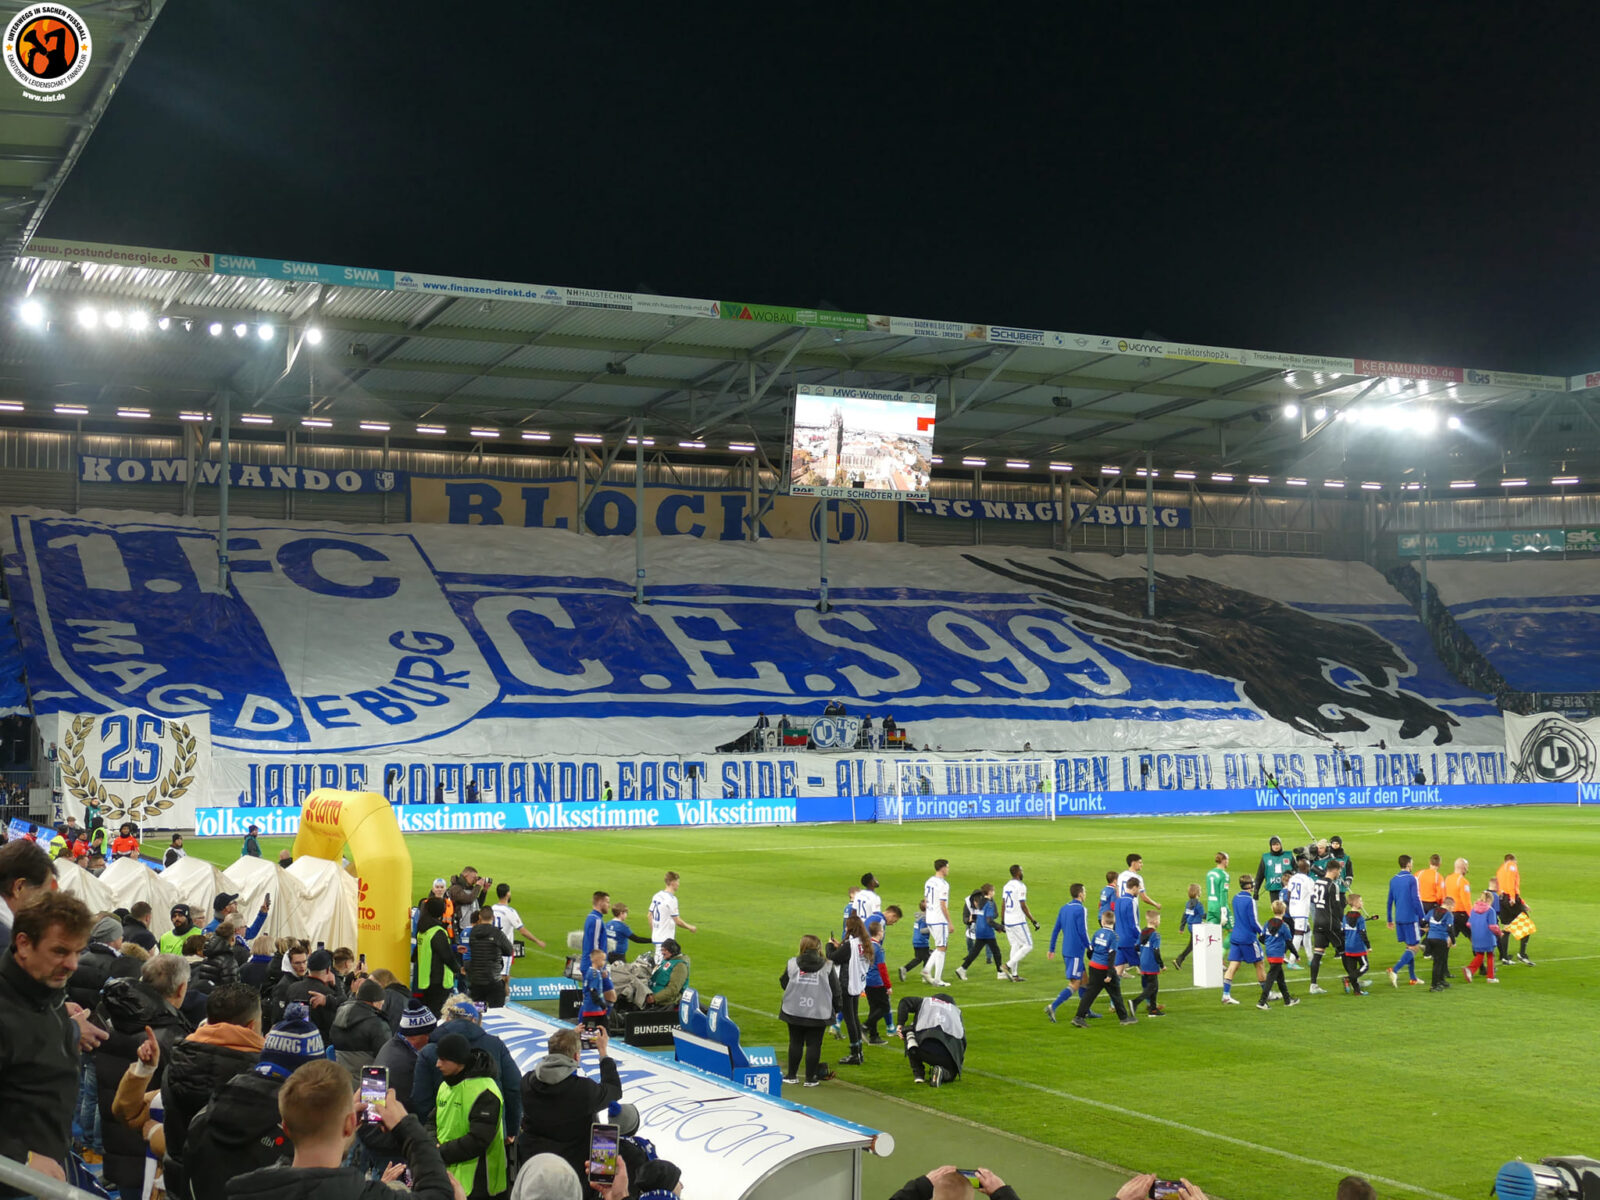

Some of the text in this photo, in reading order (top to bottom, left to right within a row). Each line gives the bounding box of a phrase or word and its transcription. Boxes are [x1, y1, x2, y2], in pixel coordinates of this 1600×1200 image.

[26, 243, 178, 265] www.postundenergie.de
[219, 255, 256, 271] SWM
[282, 262, 319, 277] SWM
[343, 267, 380, 283] SWM
[423, 280, 537, 299] www.finanzen-direkt.de
[579, 289, 633, 302] HAUSTECHNIK
[753, 310, 794, 324] WOBAU
[990, 326, 1043, 342] SCHUBERT
[1362, 361, 1455, 378] KERAMUNDO.de
[833, 388, 903, 402] MWG-Wohnen.de
[82, 456, 362, 492] KOMMANDO
[821, 489, 892, 499] CURT SCHRÖTER
[445, 483, 774, 541] BLOCK
[1457, 535, 1495, 547] SWM
[1512, 534, 1551, 546] SWM
[472, 595, 1131, 698] C.E.S.99
[65, 618, 472, 733] MAGDEBURG
[100, 713, 163, 784] 25
[382, 762, 602, 806] COMMANDO
[616, 761, 707, 803] EAST
[722, 760, 798, 801] SIDE
[1055, 756, 1111, 793] DEN
[1224, 753, 1307, 790] ALLES
[1316, 749, 1364, 788] FÜR
[1373, 754, 1425, 786] DEN
[883, 797, 911, 816] Wir
[995, 794, 1021, 813] auf
[1027, 793, 1053, 813] den
[1058, 793, 1106, 812] Punkt.
[1255, 790, 1278, 807] Wir
[1349, 788, 1371, 805] auf
[1374, 787, 1398, 804] den
[1402, 787, 1442, 803] Punkt.
[524, 804, 659, 828] Volksstimme
[1209, 877, 1217, 895] 1
[799, 997, 814, 1007] 20
